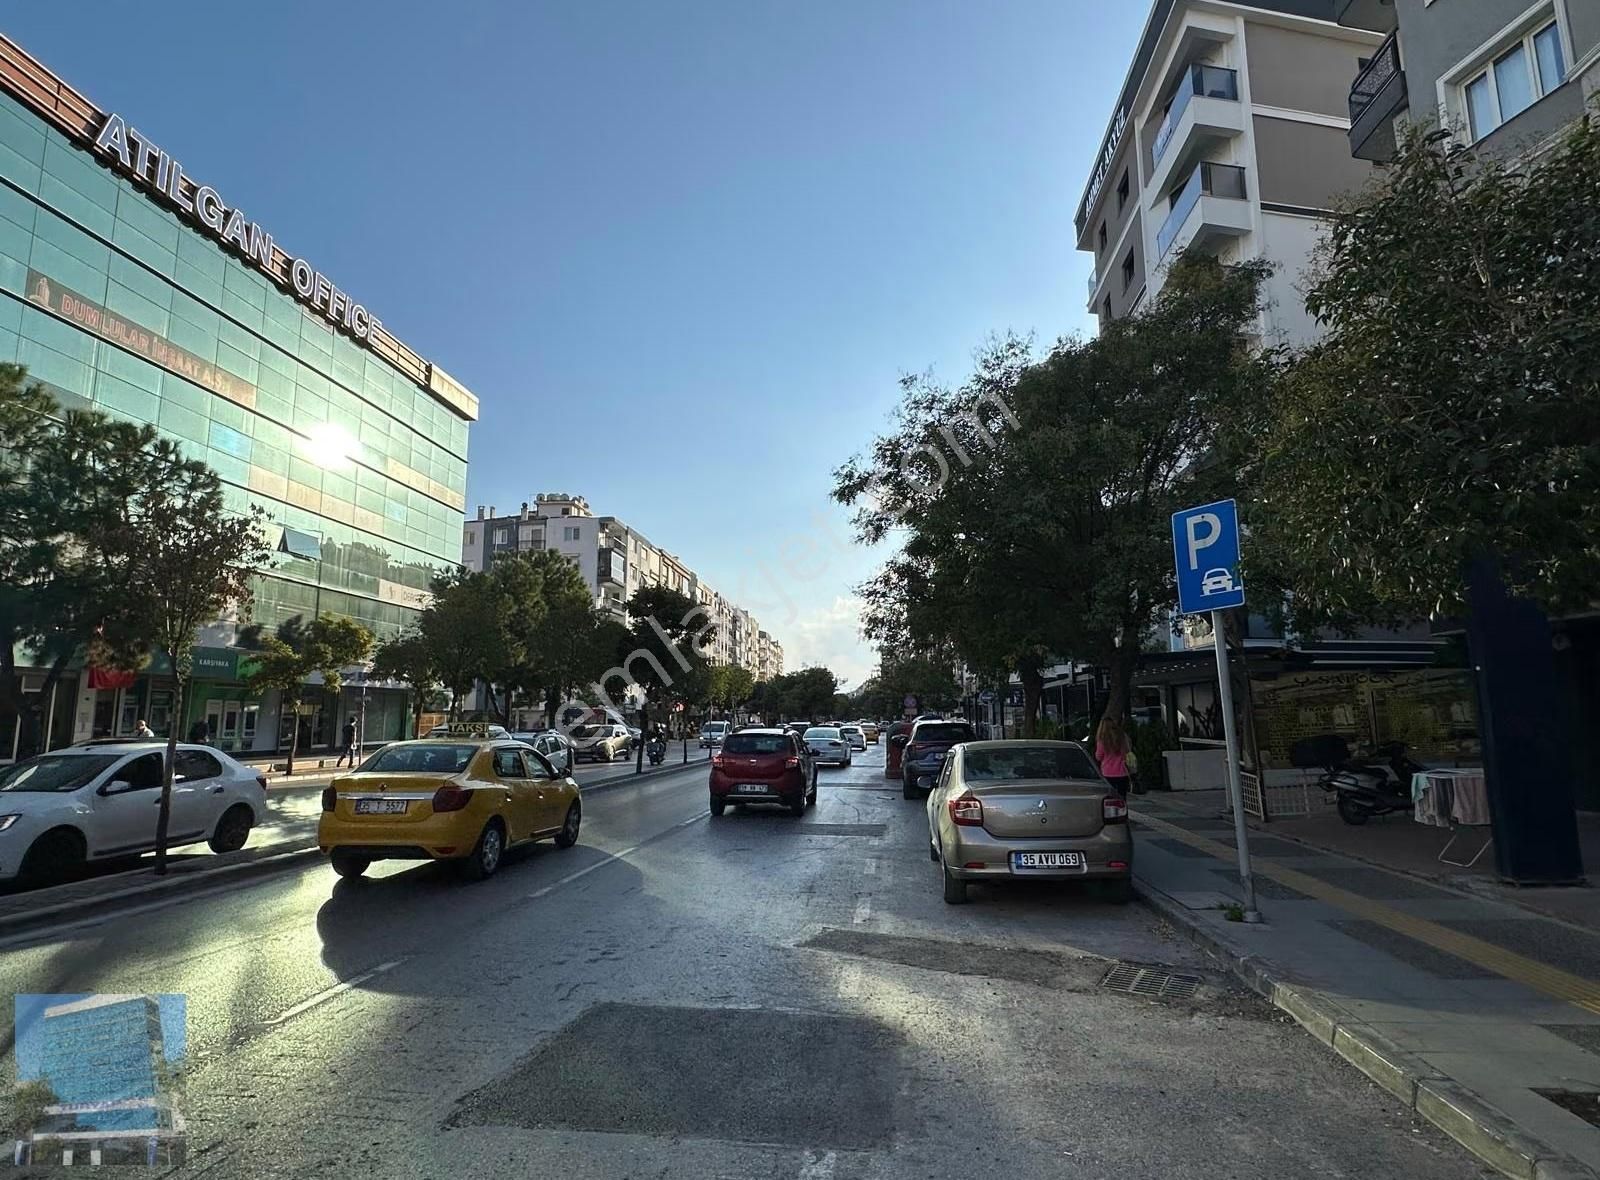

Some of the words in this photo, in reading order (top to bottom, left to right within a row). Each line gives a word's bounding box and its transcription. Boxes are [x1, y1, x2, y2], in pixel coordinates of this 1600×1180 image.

[96, 113, 274, 268] ATILGAN
[291, 258, 383, 348] OFFICE
[1186, 512, 1221, 571] P
[1023, 854, 1036, 865] 35
[1059, 854, 1077, 865] 069
